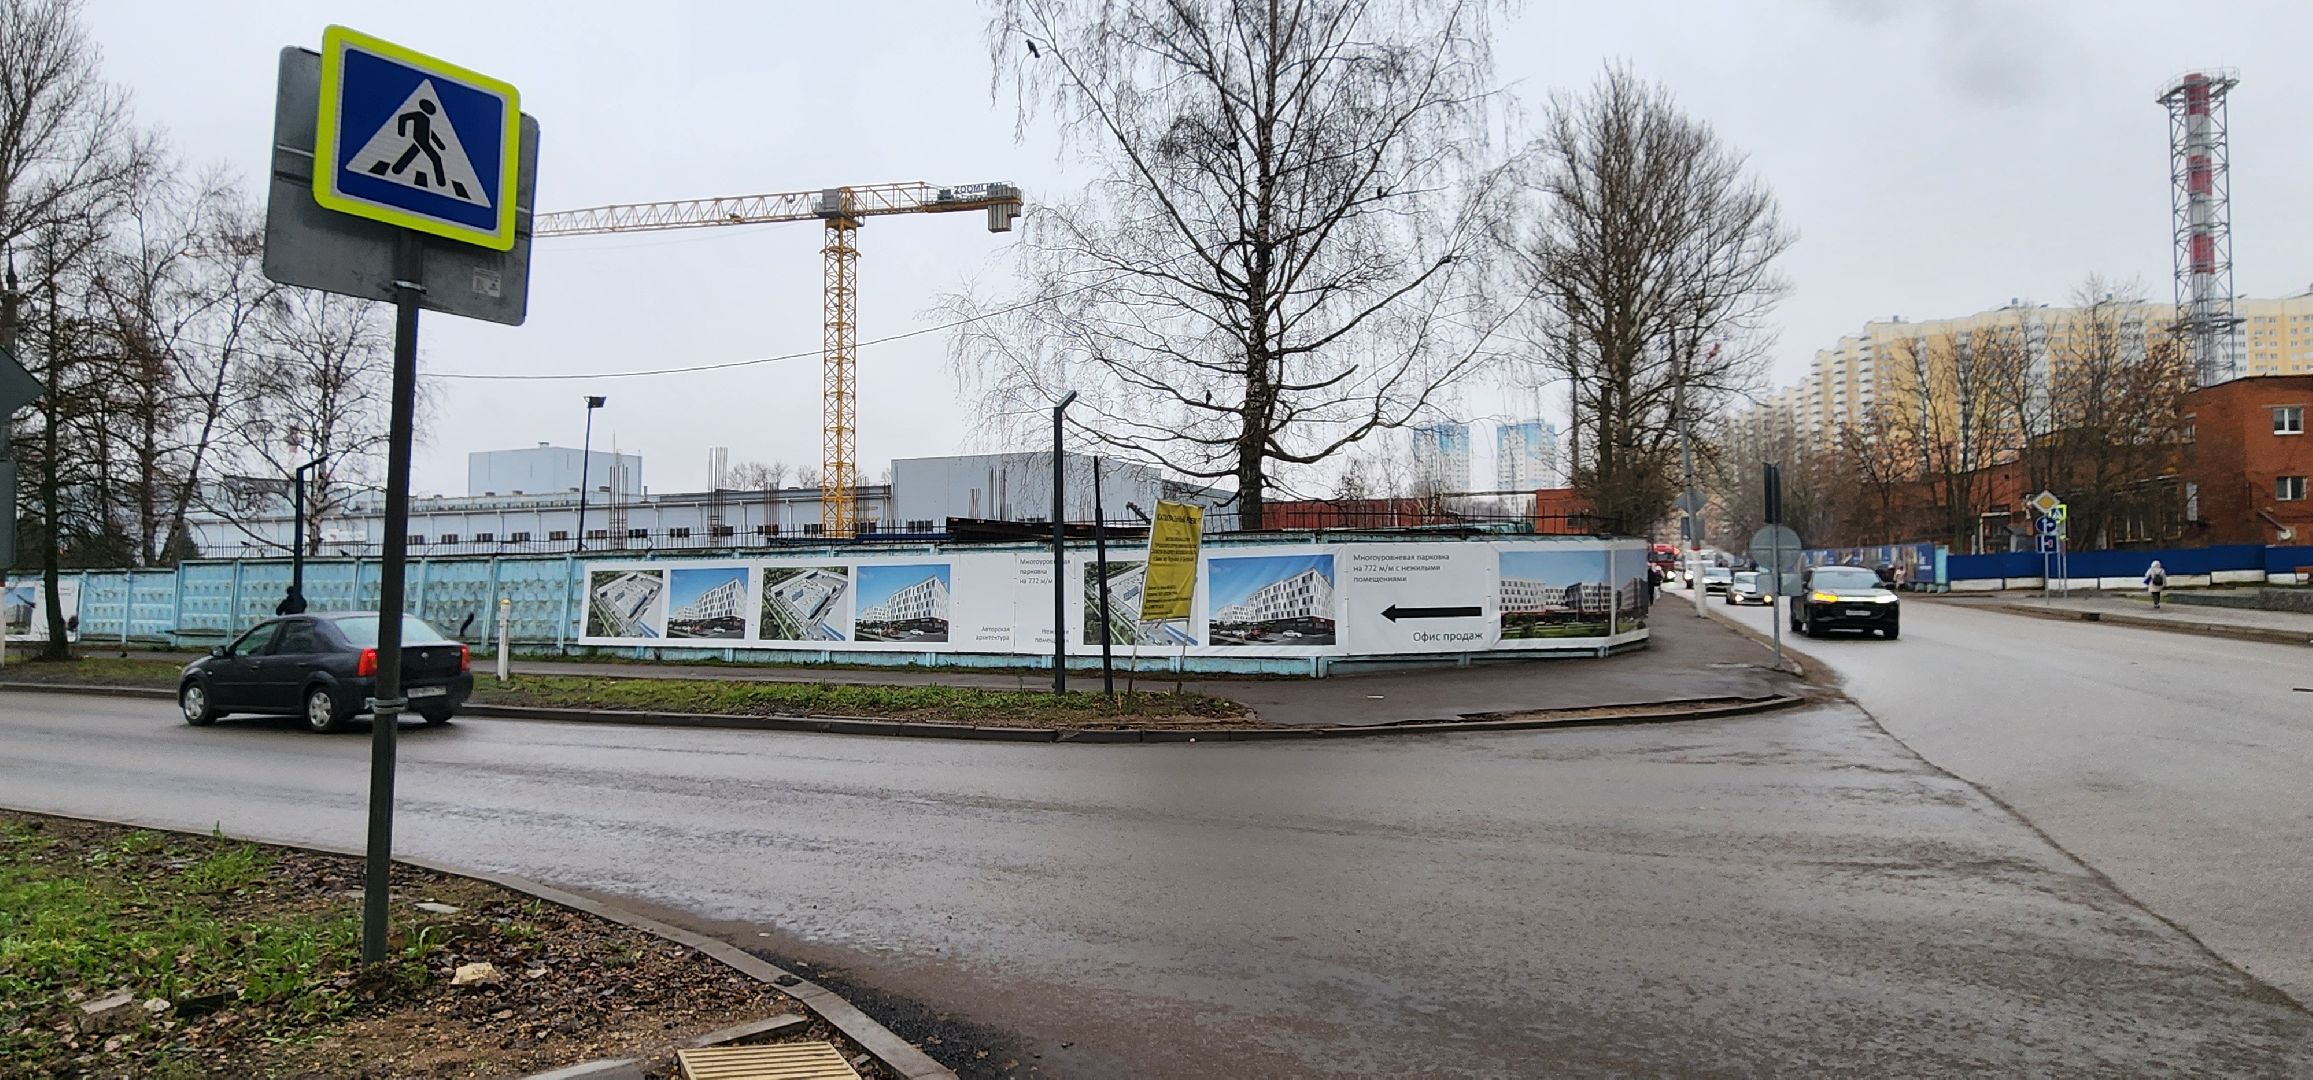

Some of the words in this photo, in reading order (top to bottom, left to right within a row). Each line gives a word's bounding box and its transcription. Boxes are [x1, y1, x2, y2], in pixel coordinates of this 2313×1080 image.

[1353, 554, 1415, 562] Многоуровневая
[1416, 554, 1450, 562] парковка
[1364, 564, 1377, 572] 772
[1378, 564, 1395, 572] м/м
[1413, 631, 1440, 642] Офис
[1443, 632, 1483, 642] продаж
